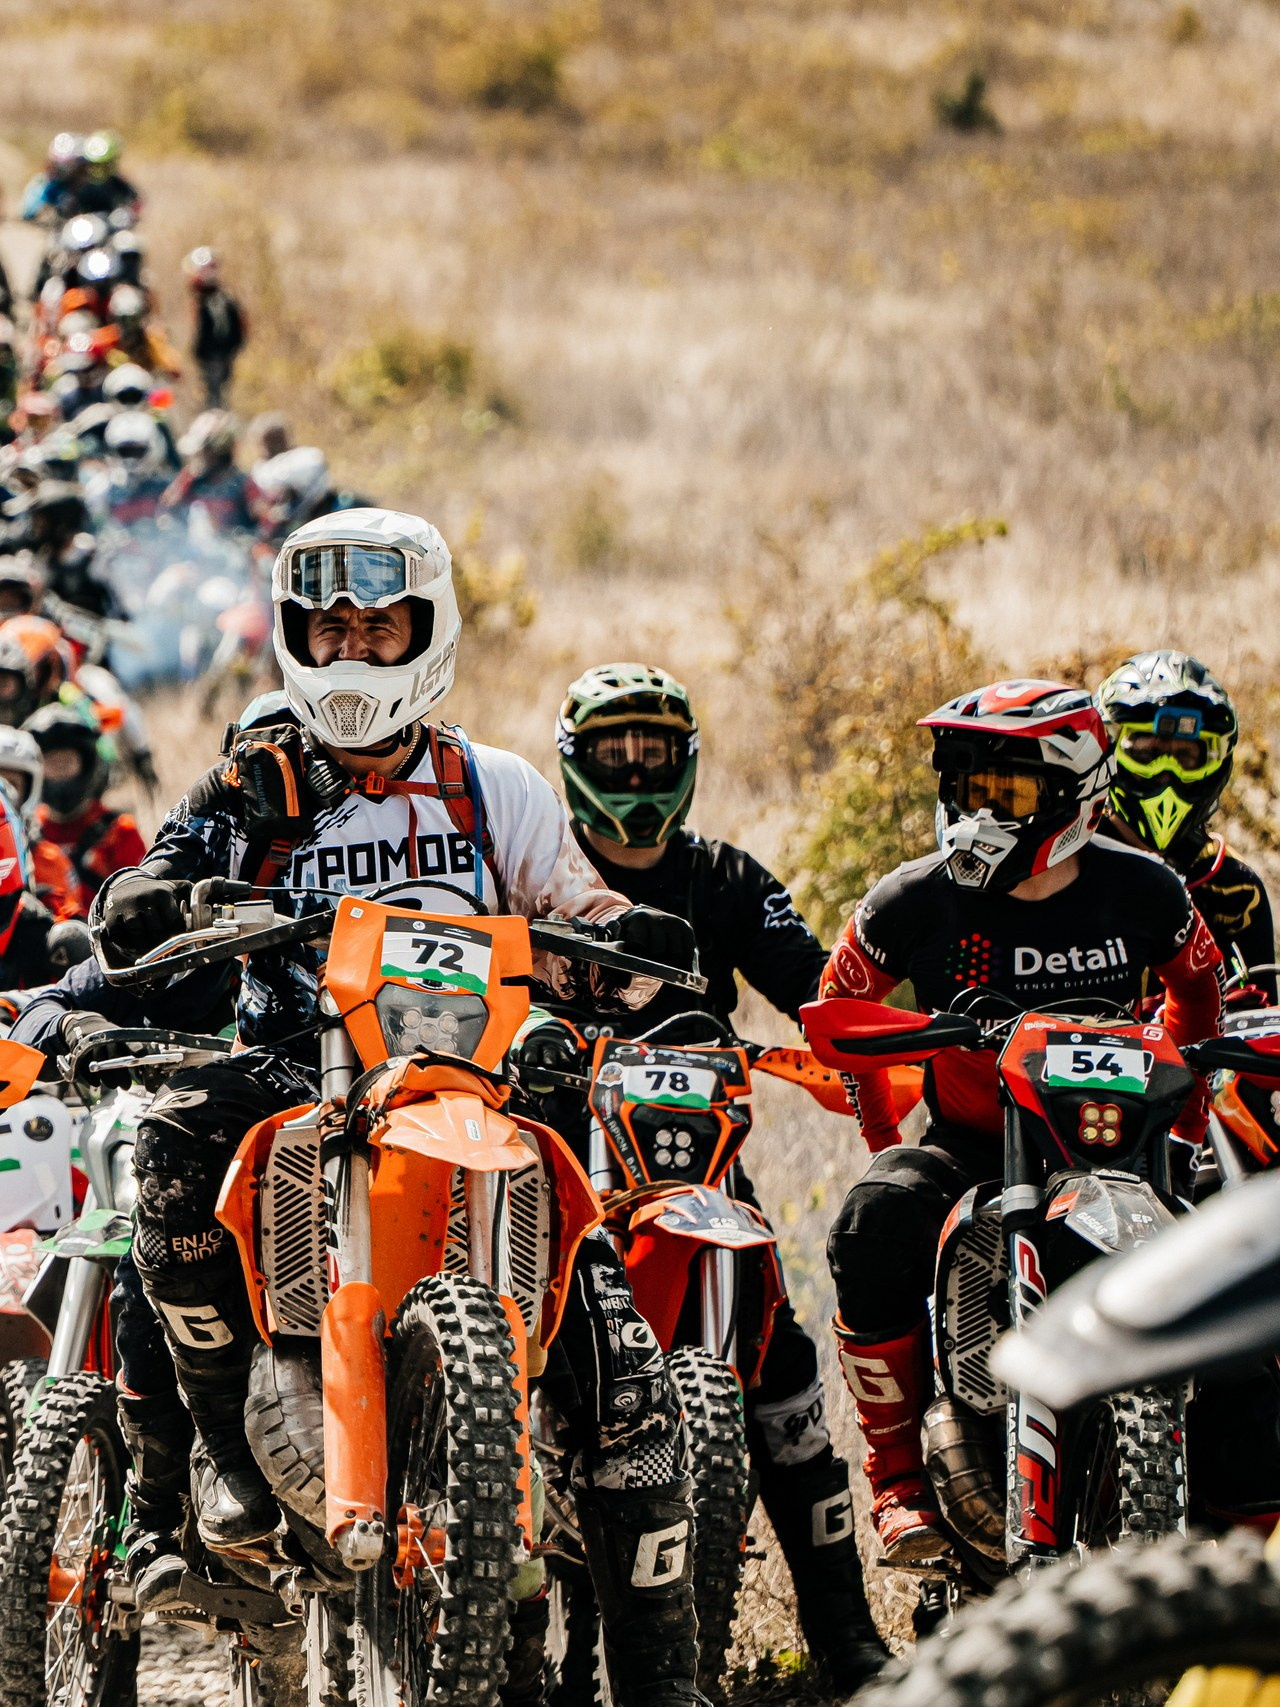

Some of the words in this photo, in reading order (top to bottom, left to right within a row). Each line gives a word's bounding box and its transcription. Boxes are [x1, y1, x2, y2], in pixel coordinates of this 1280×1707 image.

[411, 938, 464, 972] 72
[1014, 937, 1128, 976] Detail
[1015, 983, 1056, 991] SENSE
[1064, 972, 1129, 988] DIFFERENT
[1071, 1050, 1123, 1077] 54
[645, 1070, 690, 1092] 78
